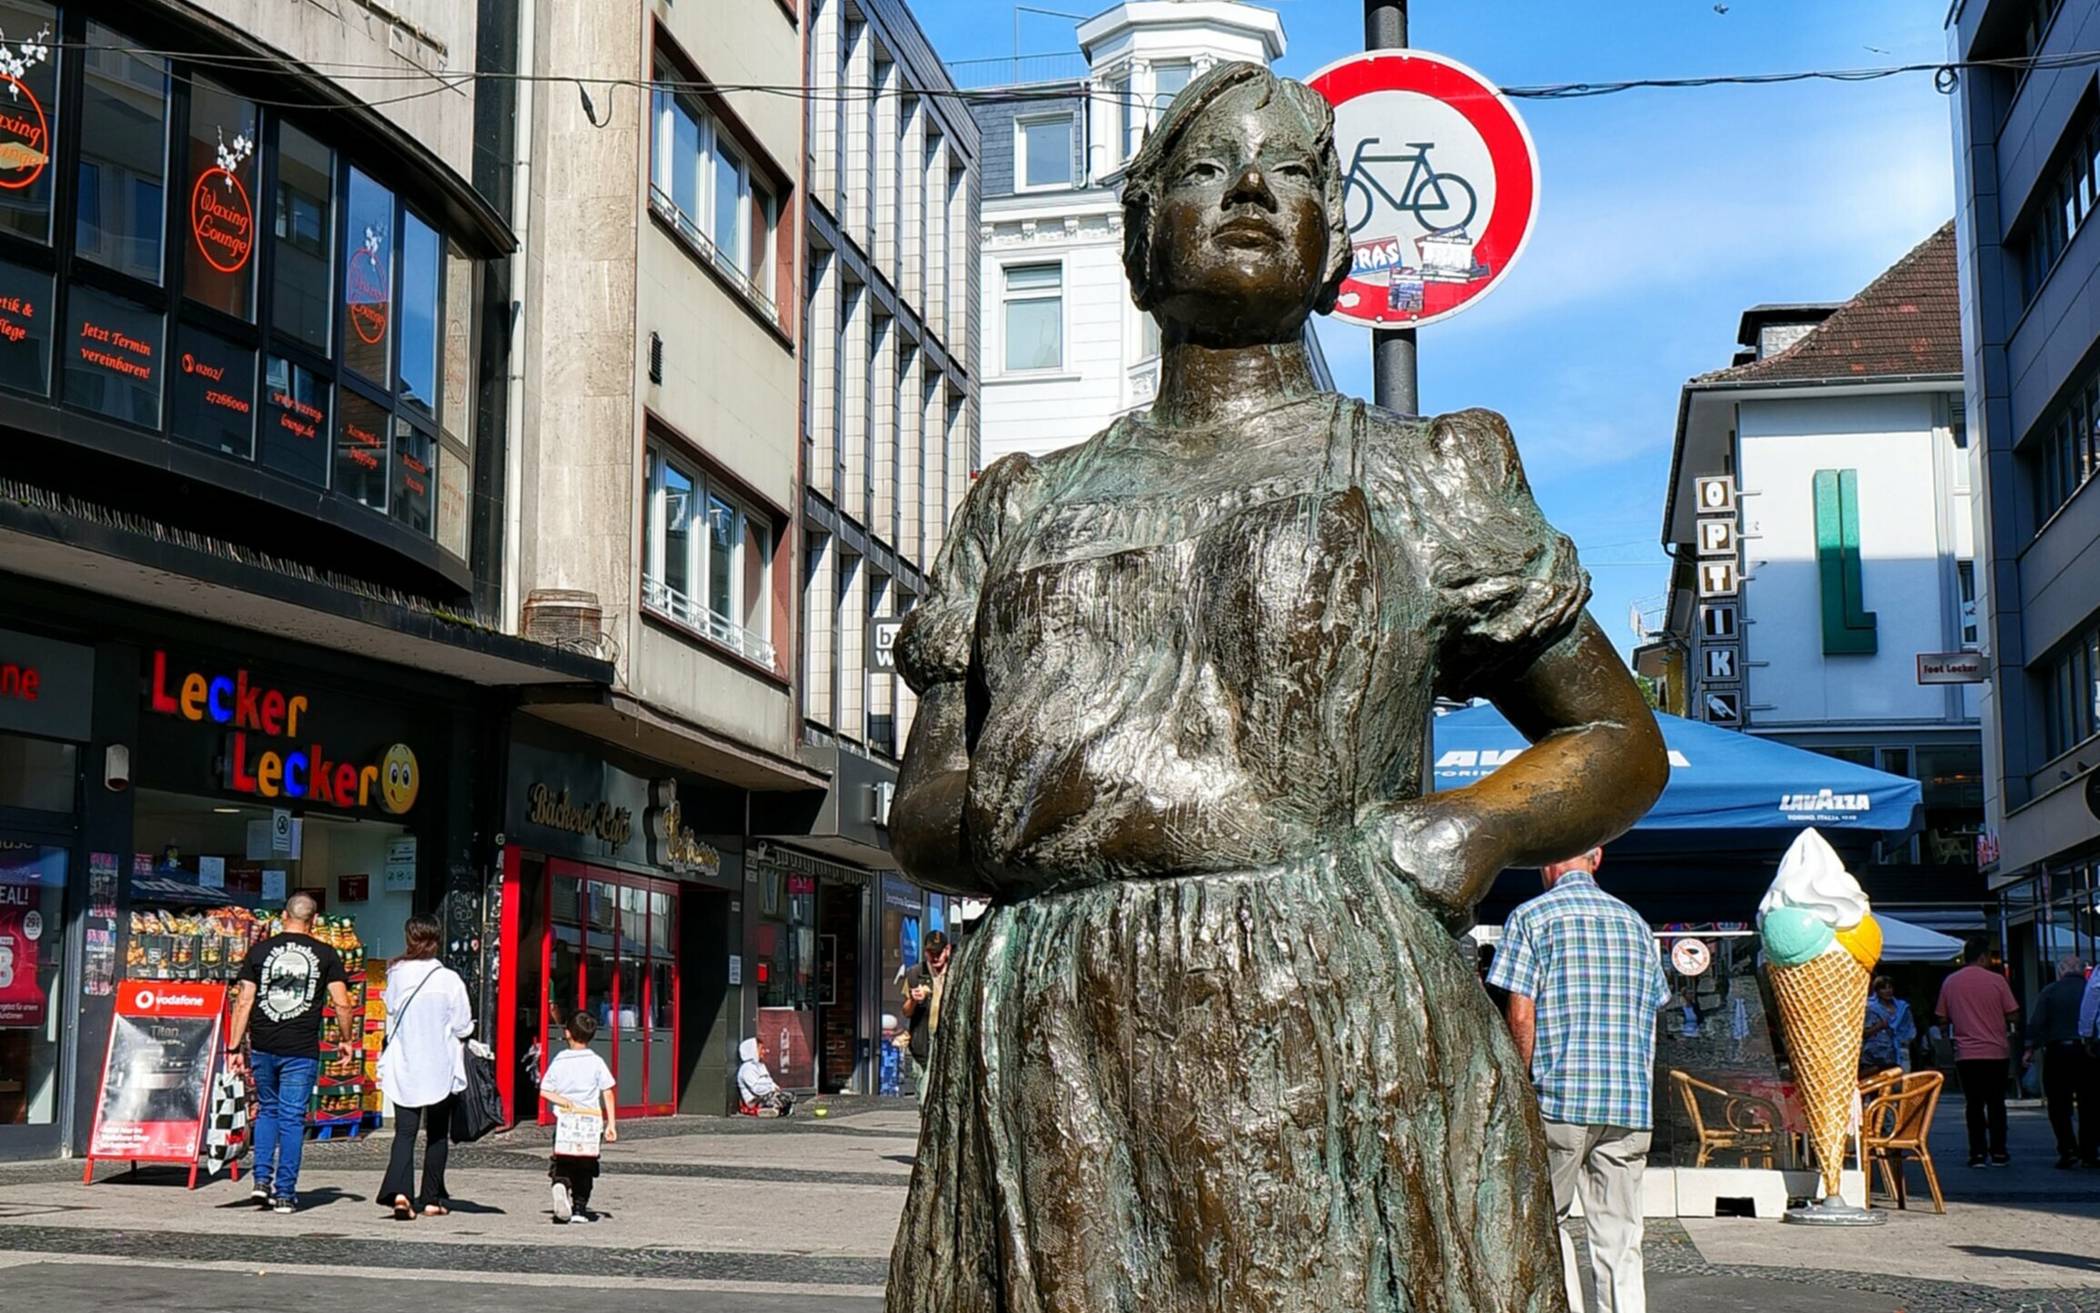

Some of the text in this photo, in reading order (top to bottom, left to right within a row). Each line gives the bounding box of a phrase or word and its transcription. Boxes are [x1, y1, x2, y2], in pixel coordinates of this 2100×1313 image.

[200, 186, 248, 235] Waxing
[198, 214, 247, 256] Lounge
[22, 303, 33, 318] &
[81, 322, 151, 356] Jetzt Termin
[80, 348, 151, 379] vereinbaren!
[195, 364, 224, 382] 0202/
[152, 650, 308, 738] Lecker
[232, 730, 379, 808] Lecker
[530, 783, 593, 836] Bäckerei
[1779, 788, 1870, 811] LAVAZZA
[156, 995, 204, 1007] vodafone
